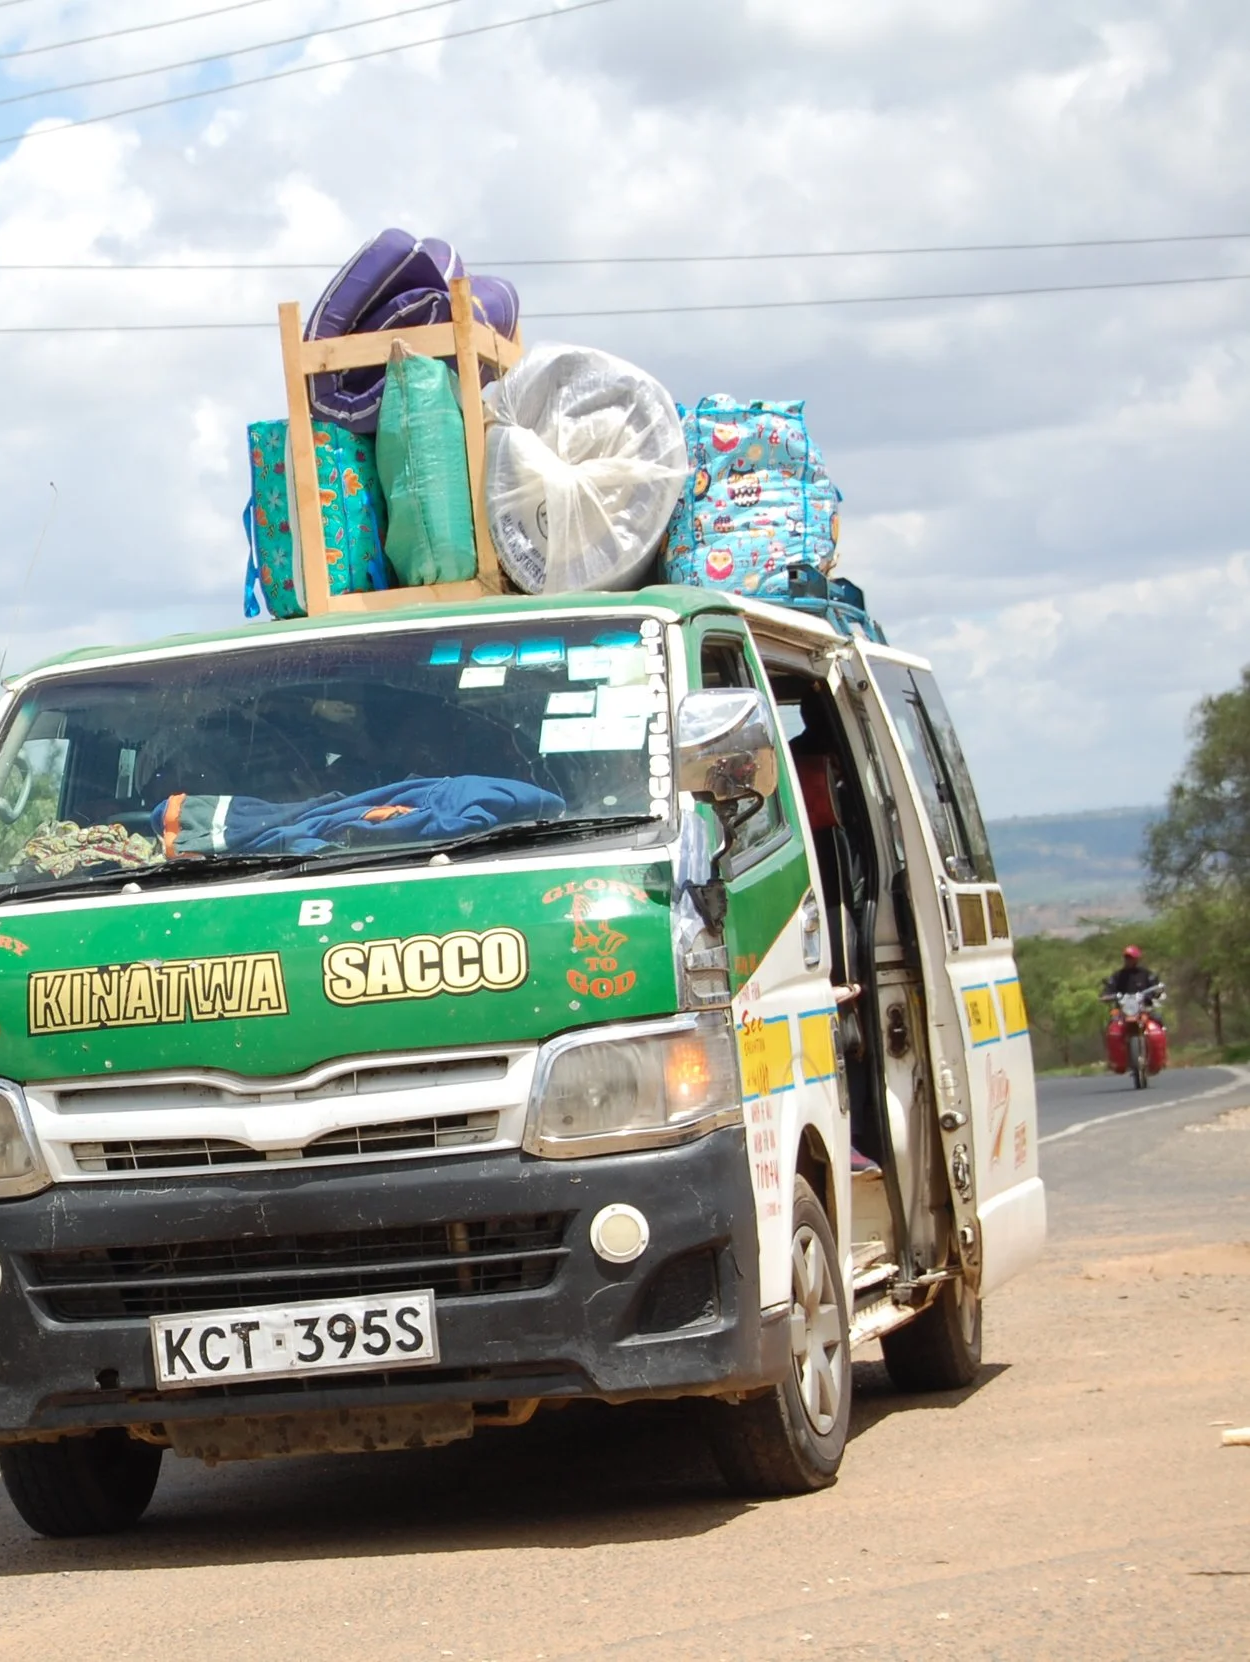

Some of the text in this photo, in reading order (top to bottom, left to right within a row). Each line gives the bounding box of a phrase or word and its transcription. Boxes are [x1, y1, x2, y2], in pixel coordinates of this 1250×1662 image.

[648, 713, 671, 822] JESUS
[542, 878, 649, 904] GLORY
[298, 900, 333, 926] B
[585, 957, 617, 971] TO
[30, 928, 525, 1035] KINATWA SACCO
[566, 969, 636, 998] GOD
[164, 1306, 424, 1376] KCT 395S
